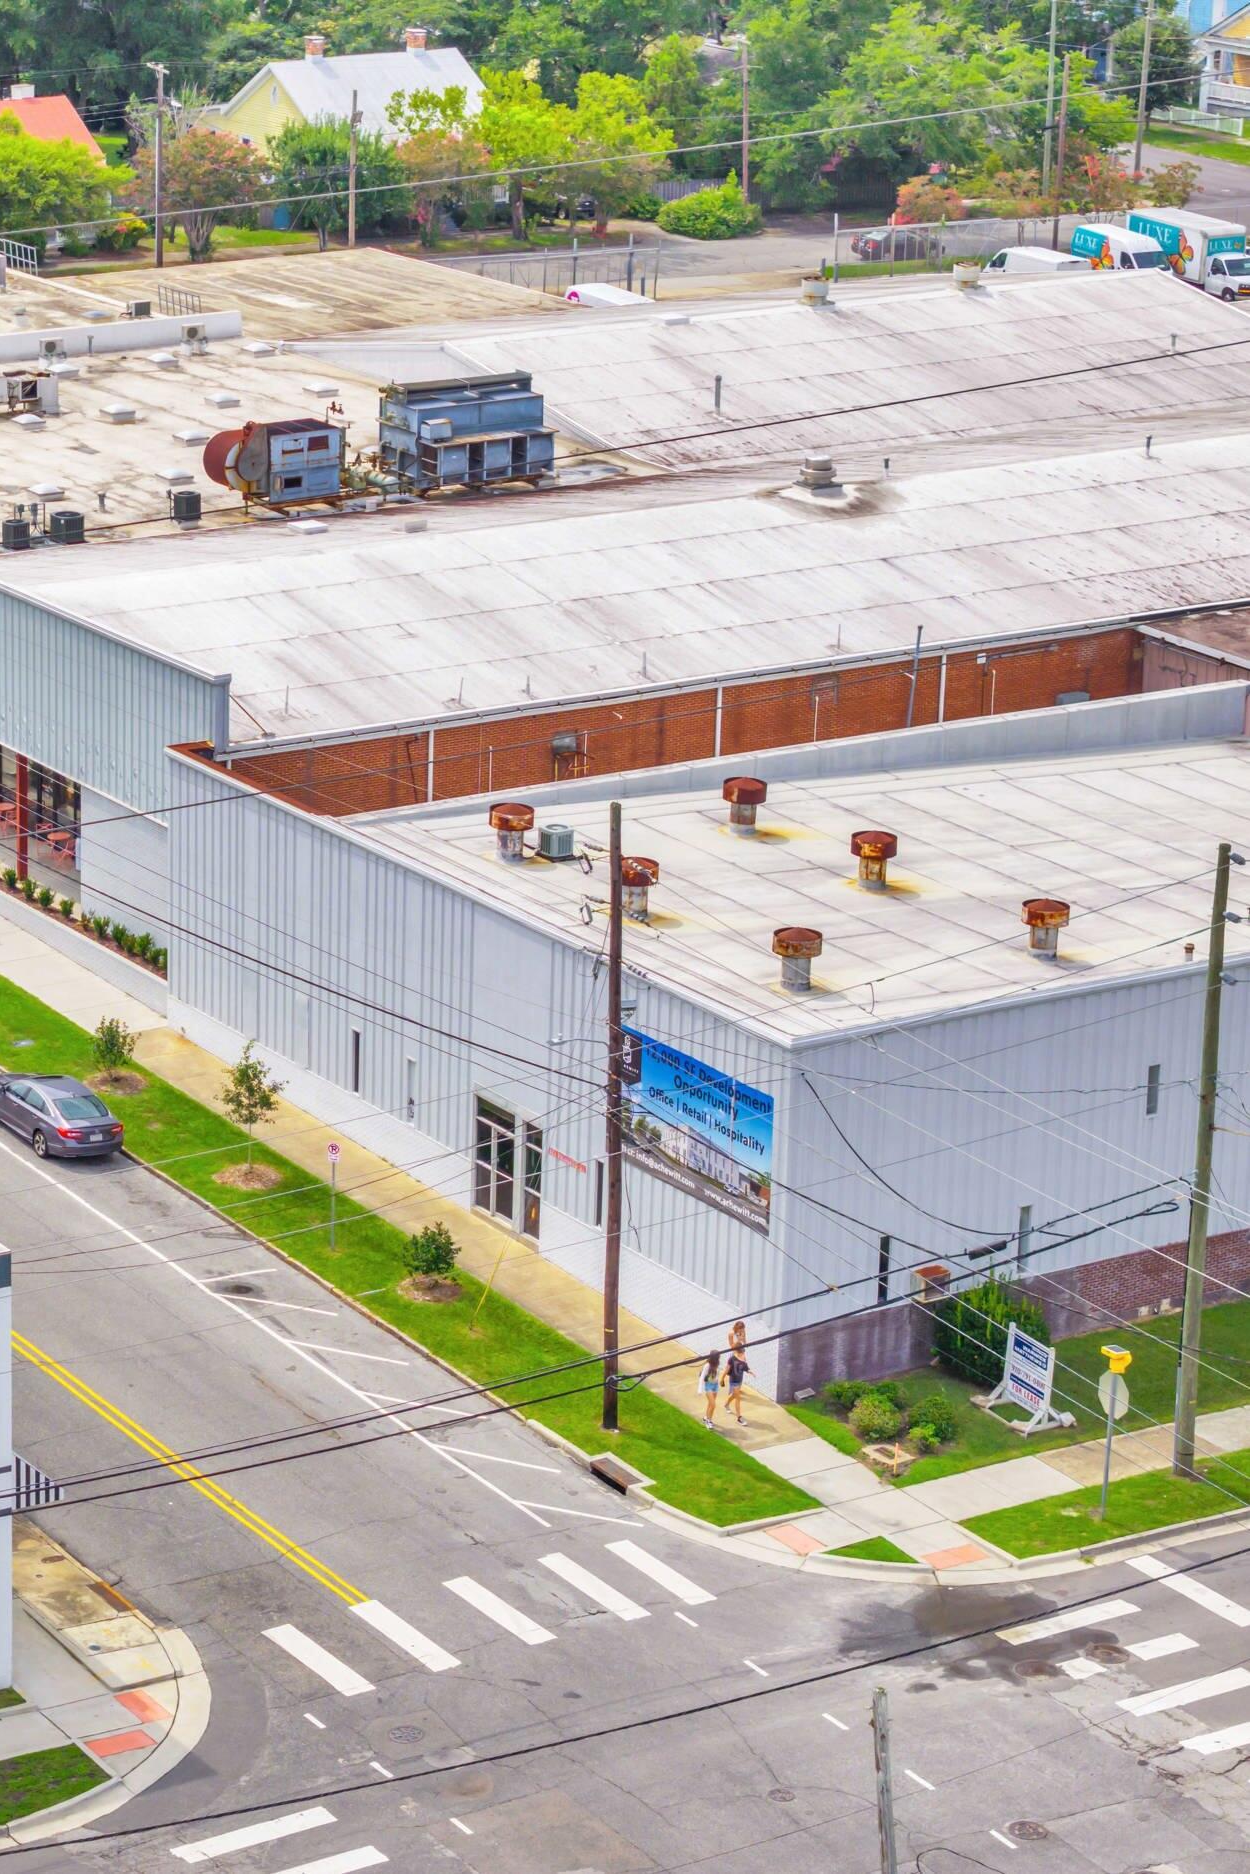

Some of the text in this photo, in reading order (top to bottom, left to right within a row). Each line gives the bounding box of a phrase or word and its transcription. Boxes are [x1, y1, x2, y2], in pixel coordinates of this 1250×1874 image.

[1074, 232, 1098, 249] LUXE
[1139, 221, 1172, 243] LUXE
[1209, 239, 1232, 251] LUXE
[673, 1074, 739, 1121] Opportunity
[699, 1067, 772, 1113] Development
[648, 1086, 674, 1108] Office
[682, 1102, 707, 1125] Retail
[714, 1118, 766, 1156] Hospitality
[1011, 1383, 1023, 1396] FOR
[1023, 1391, 1041, 1407] LEASE
